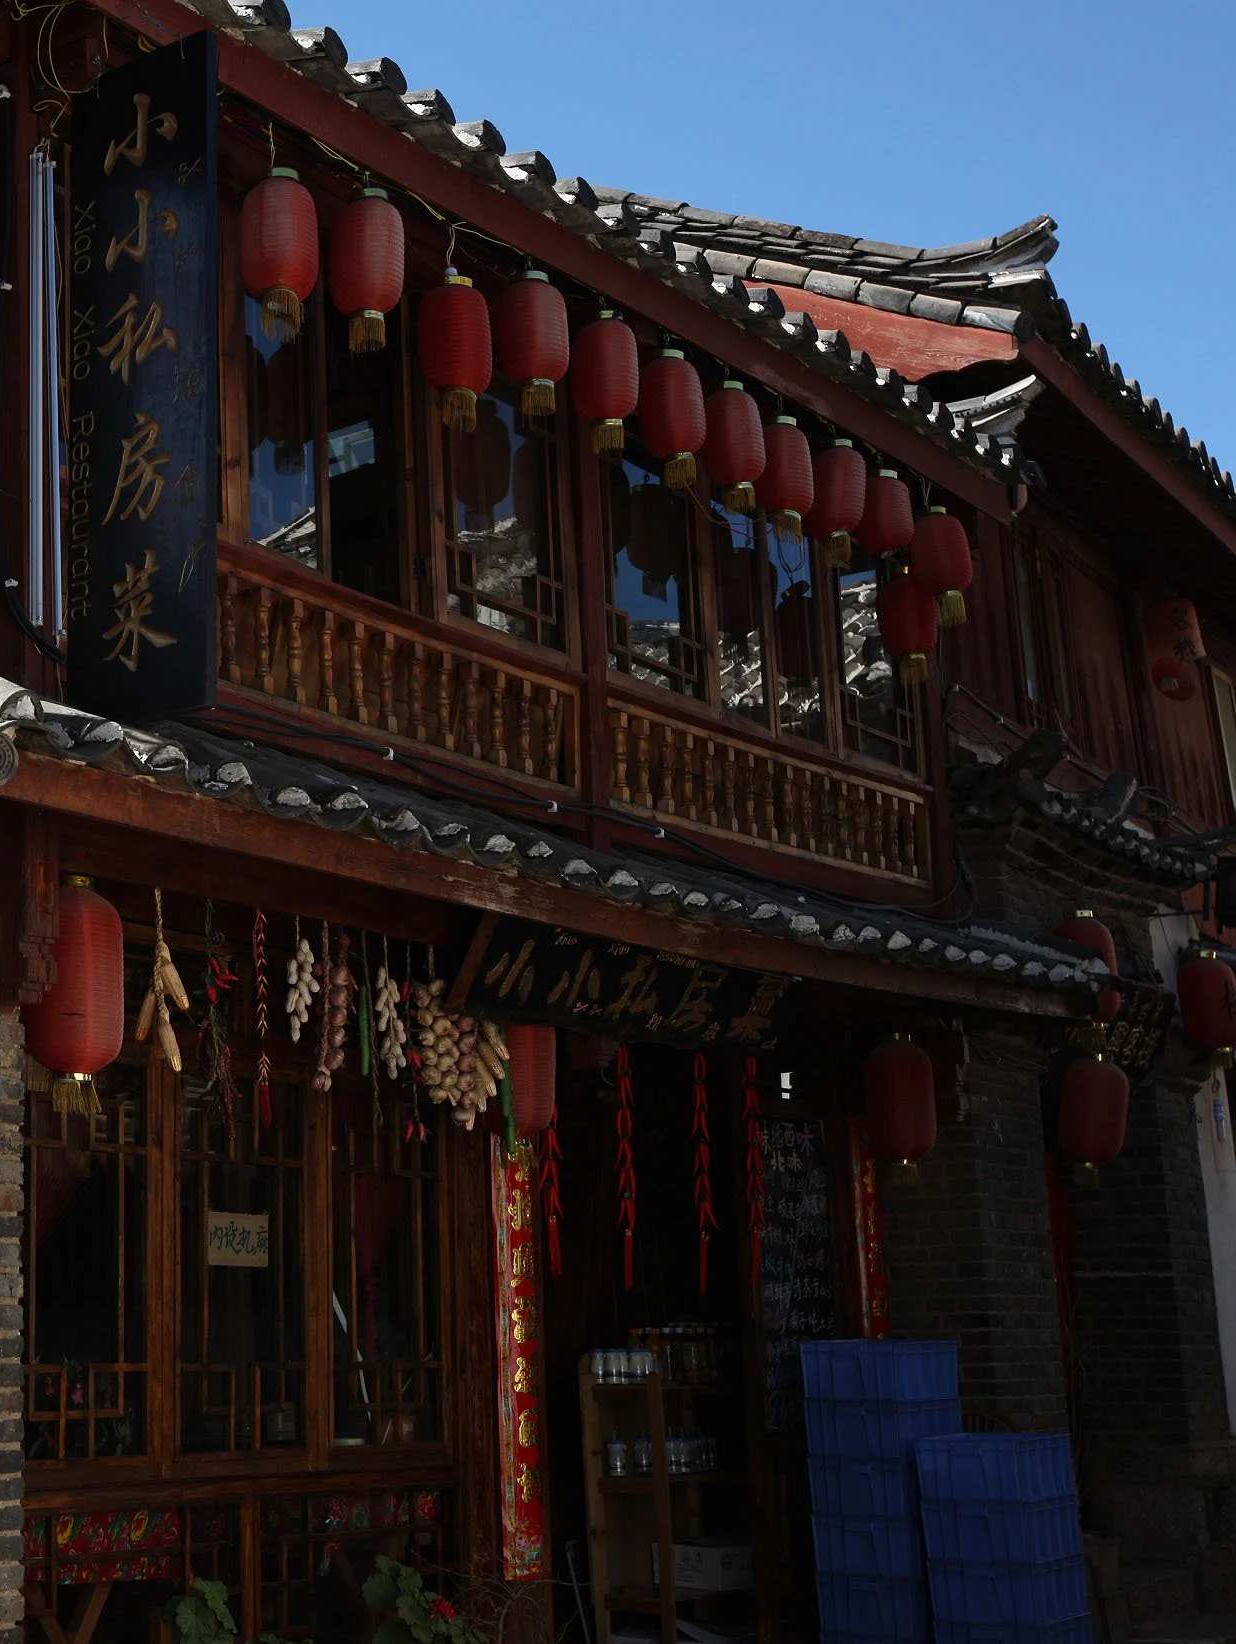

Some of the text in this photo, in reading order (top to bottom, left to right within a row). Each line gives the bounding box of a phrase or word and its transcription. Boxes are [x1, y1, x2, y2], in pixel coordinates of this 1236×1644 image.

[71, 200, 96, 618] Xiao Xiao Restaurant
[99, 92, 178, 672] 小小私房菜
[483, 938, 788, 1041] 小小私房菜
